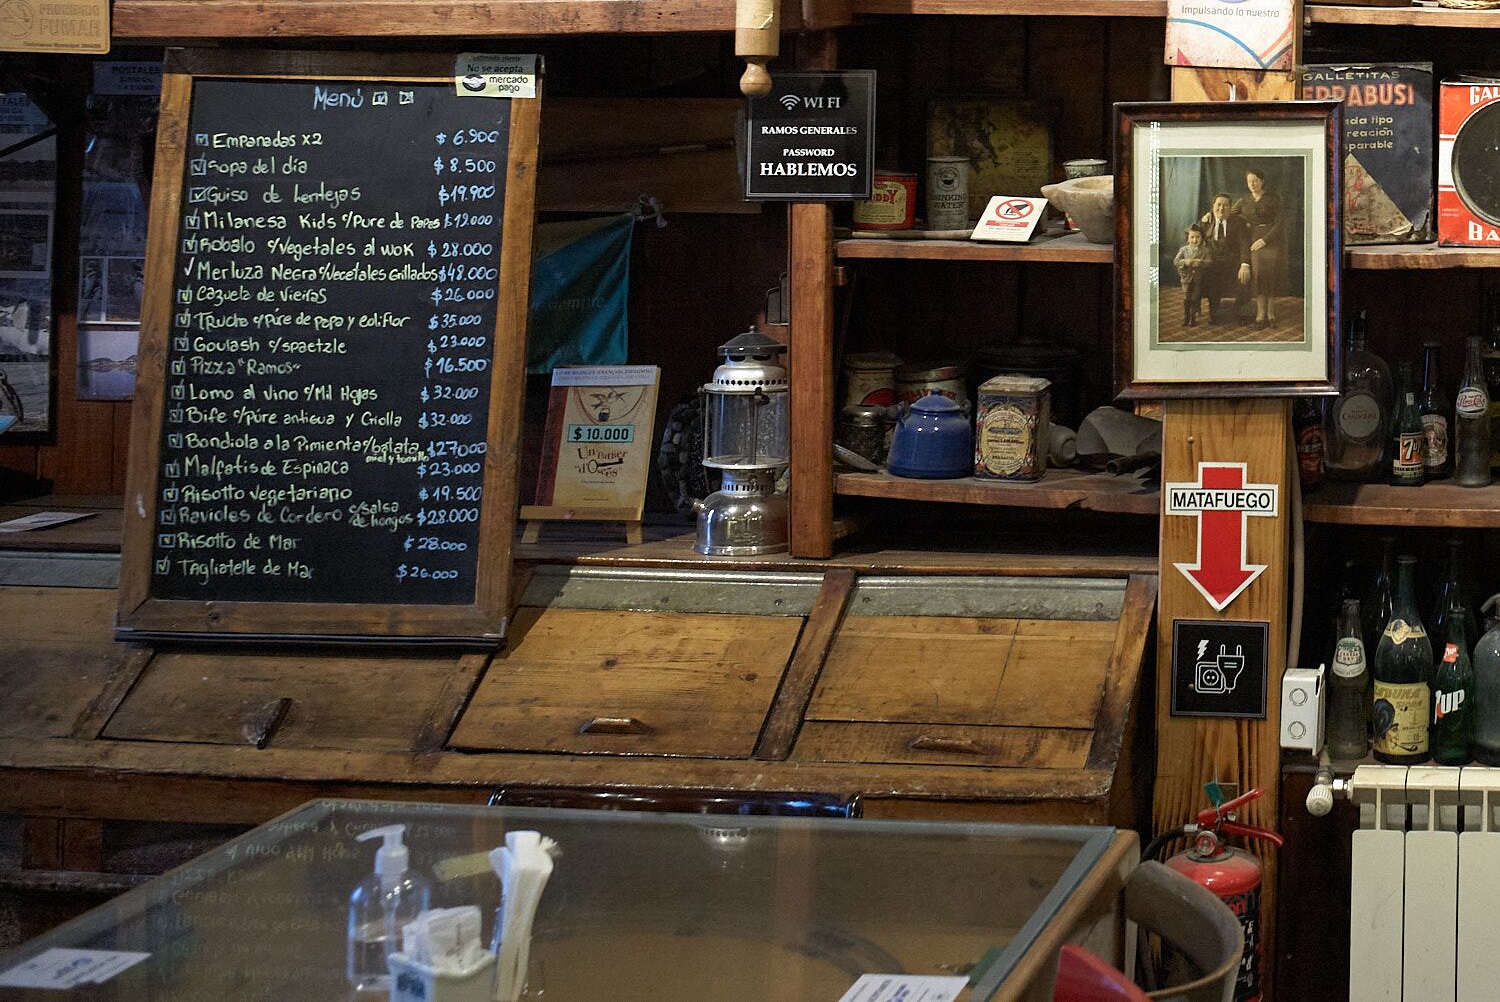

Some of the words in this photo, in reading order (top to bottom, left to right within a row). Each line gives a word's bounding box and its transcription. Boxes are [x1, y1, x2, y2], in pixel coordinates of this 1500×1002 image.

[1181, 5, 1234, 16] Impulsando
[1235, 6, 1244, 16] lo
[1246, 8, 1280, 18] nuestro
[467, 64, 480, 73] No
[494, 65, 524, 75] acepta
[489, 75, 529, 85] mercado
[1302, 71, 1400, 82] GALLETITAS
[498, 84, 521, 94] pago
[313, 86, 364, 110] Menú
[803, 97, 823, 109] WI
[827, 97, 841, 109] FI
[1371, 115, 1393, 127] tipo
[761, 126, 798, 135] RAMOS
[799, 126, 858, 135] GENERALES
[783, 148, 835, 157] PASSWORD
[252, 157, 276, 175] del
[450, 157, 496, 174] 8.500
[760, 162, 858, 177] HABLEMOS
[263, 184, 283, 203] de
[573, 427, 582, 440] $
[586, 428, 629, 440] 10.000
[1172, 489, 1271, 510] MATAFUEGO
